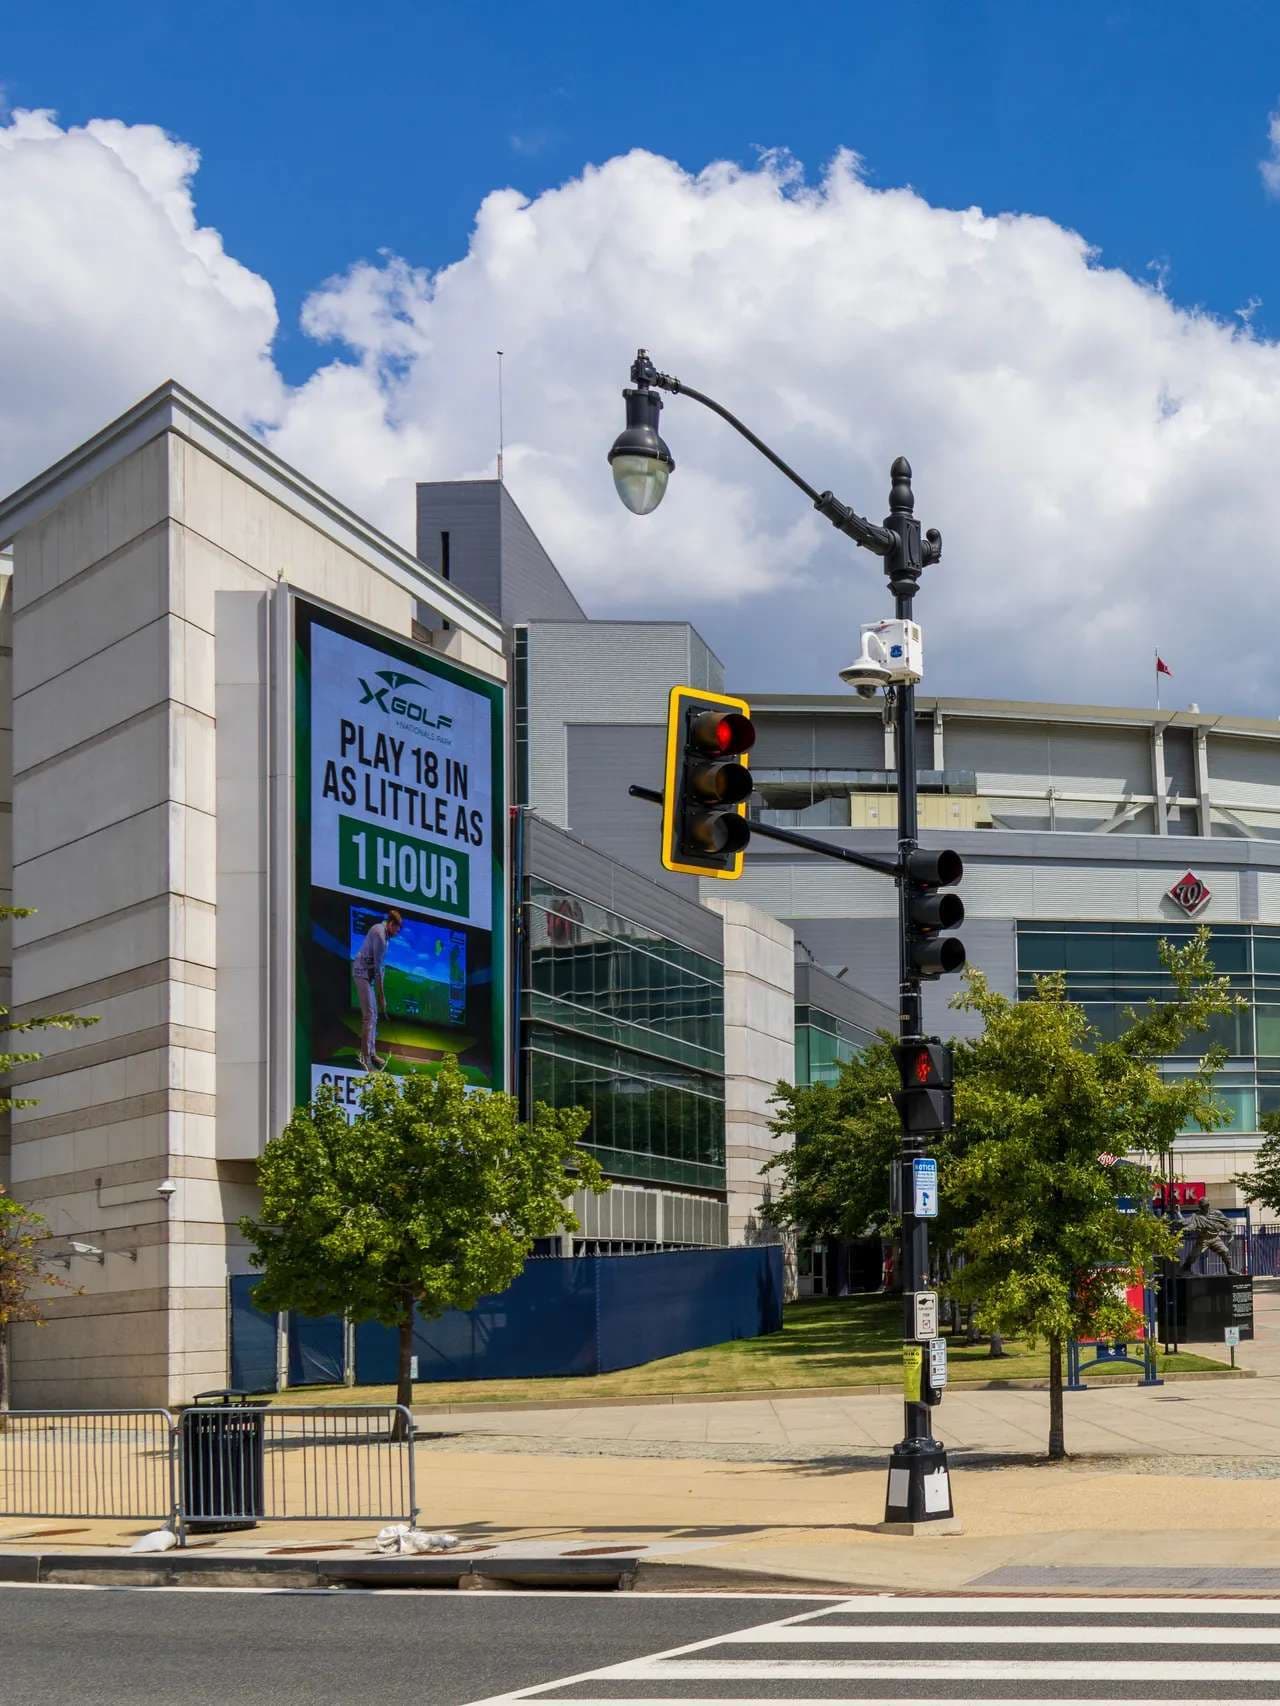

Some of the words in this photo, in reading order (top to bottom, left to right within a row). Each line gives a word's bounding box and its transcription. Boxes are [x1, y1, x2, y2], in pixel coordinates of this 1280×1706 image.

[340, 719, 405, 777] PLAY
[411, 747, 439, 789] 18
[445, 758, 468, 801] IN
[322, 760, 357, 806] AS
[365, 773, 448, 836] LITTLE
[454, 805, 484, 847] AS
[352, 831, 367, 880] 1
[376, 836, 458, 905] HOUR
